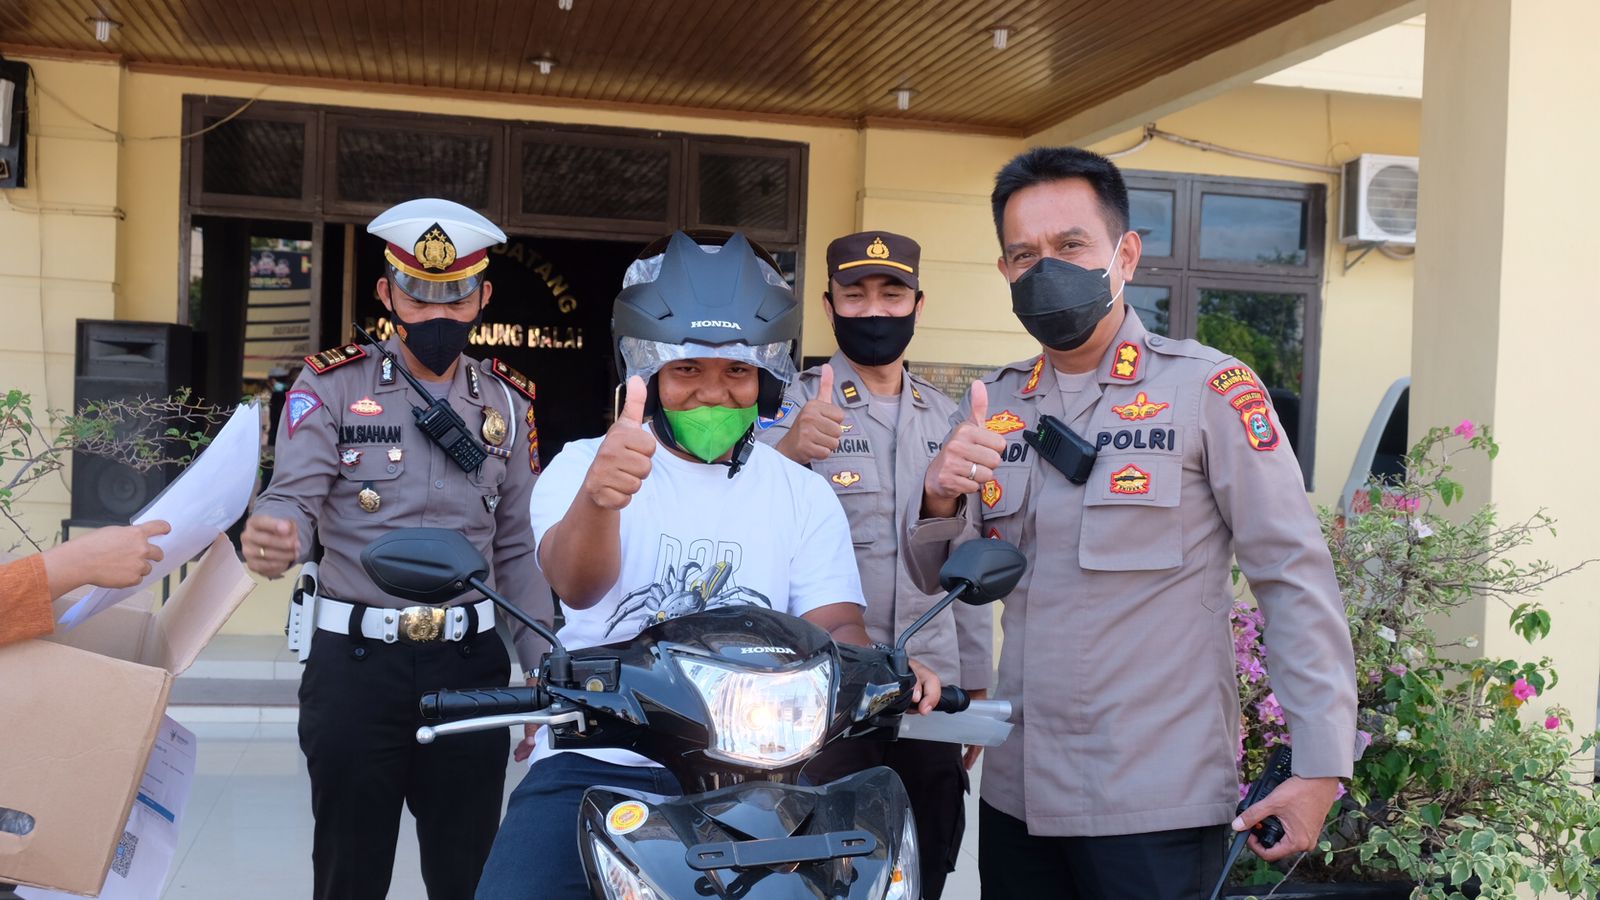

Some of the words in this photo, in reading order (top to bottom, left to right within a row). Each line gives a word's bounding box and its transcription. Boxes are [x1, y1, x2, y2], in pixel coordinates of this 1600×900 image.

[690, 320, 742, 330] HONDA
[1096, 428, 1175, 452] POLRI
[831, 439, 870, 454] AGIAN
[740, 646, 797, 655] HONDA
